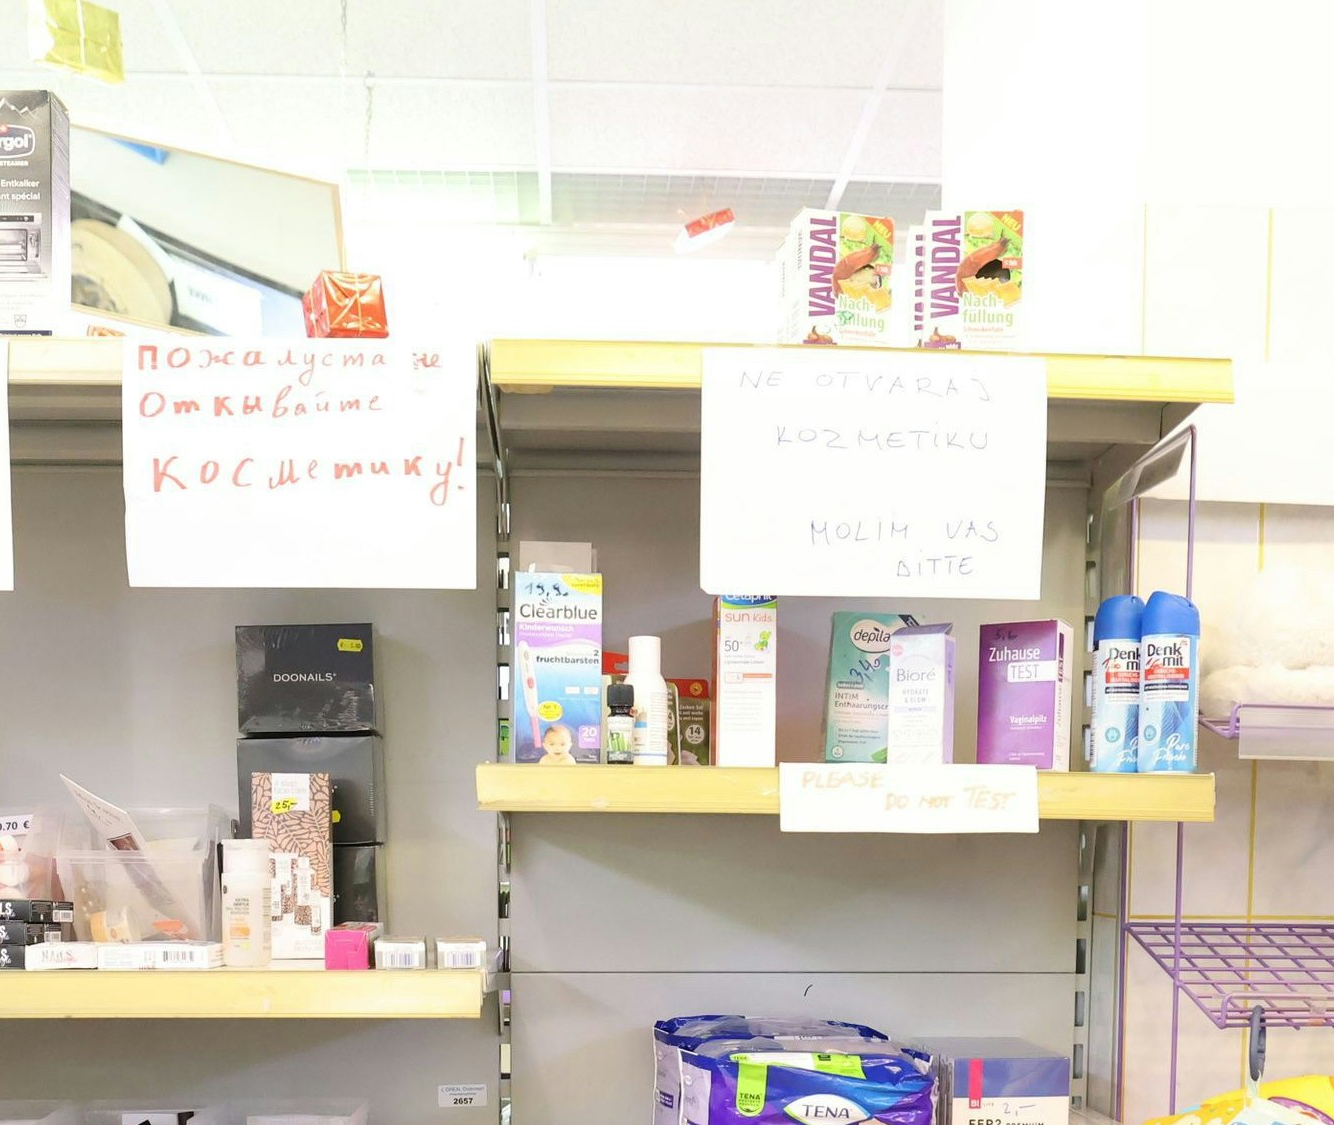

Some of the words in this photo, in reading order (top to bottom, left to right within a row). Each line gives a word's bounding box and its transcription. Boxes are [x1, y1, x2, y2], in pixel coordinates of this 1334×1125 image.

[10, 191, 41, 204] spécial
[808, 215, 838, 318] VANDAL
[930, 215, 962, 319] VANDAL
[838, 297, 876, 313] Nach-
[962, 293, 1005, 309] Nach-
[962, 309, 1015, 328] füllung
[739, 370, 783, 389] NE
[810, 518, 910, 546] MOLIM
[519, 603, 599, 620] Clearblue
[723, 611, 751, 623] sun
[988, 646, 1041, 662] Zuhause
[1147, 642, 1182, 658] Denk
[535, 655, 599, 666] fruchtbarsten
[1163, 655, 1184, 668] mit
[273, 673, 334, 683] DOONAILS
[896, 668, 937, 682] Bioré
[1011, 664, 1038, 681] TEST
[834, 692, 859, 701] INTIM
[688, 725, 701, 737] 14
[800, 769, 885, 790] PLEASE
[23, 819, 32, 830] €
[453, 1097, 474, 1105] 2657
[739, 1091, 761, 1100] TENA
[800, 1102, 850, 1119] TENA
